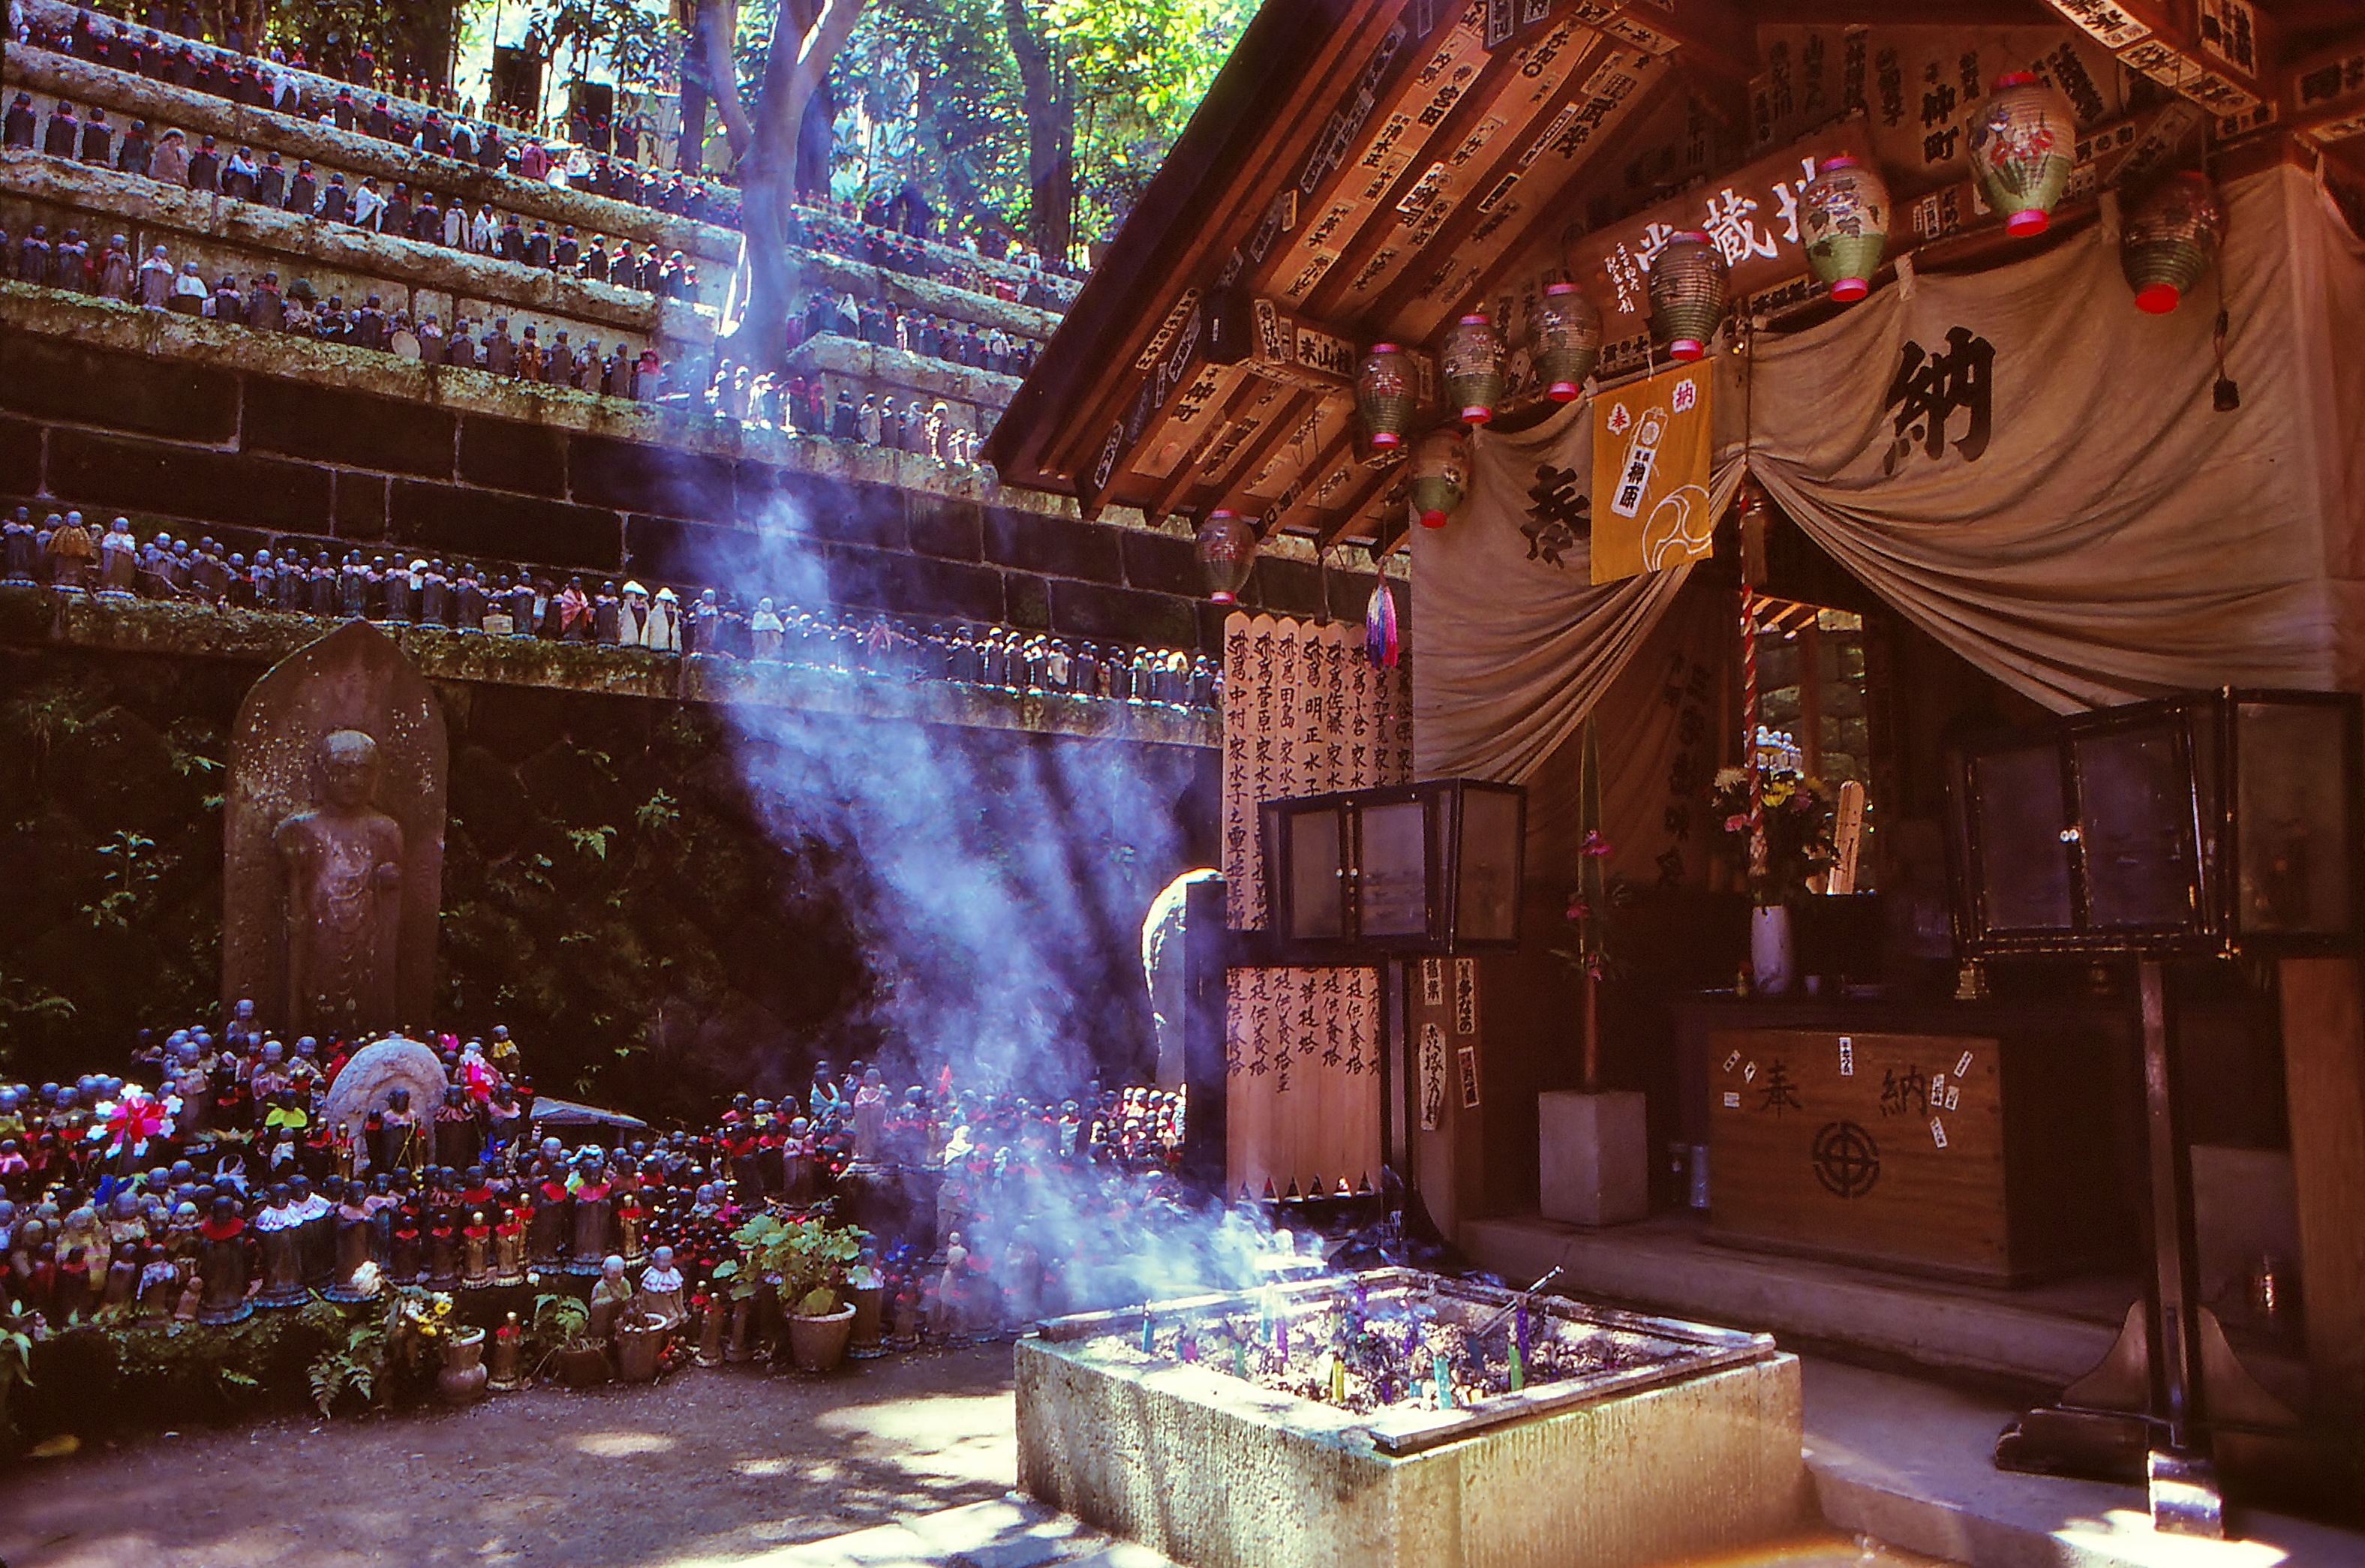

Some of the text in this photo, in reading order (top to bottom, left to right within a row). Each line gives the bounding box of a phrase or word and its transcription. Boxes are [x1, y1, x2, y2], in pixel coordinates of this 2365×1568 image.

[1609, 380, 1695, 432] 奉 納
[1883, 325, 1996, 476] 納
[1757, 1059, 1928, 1119] 奉 納
